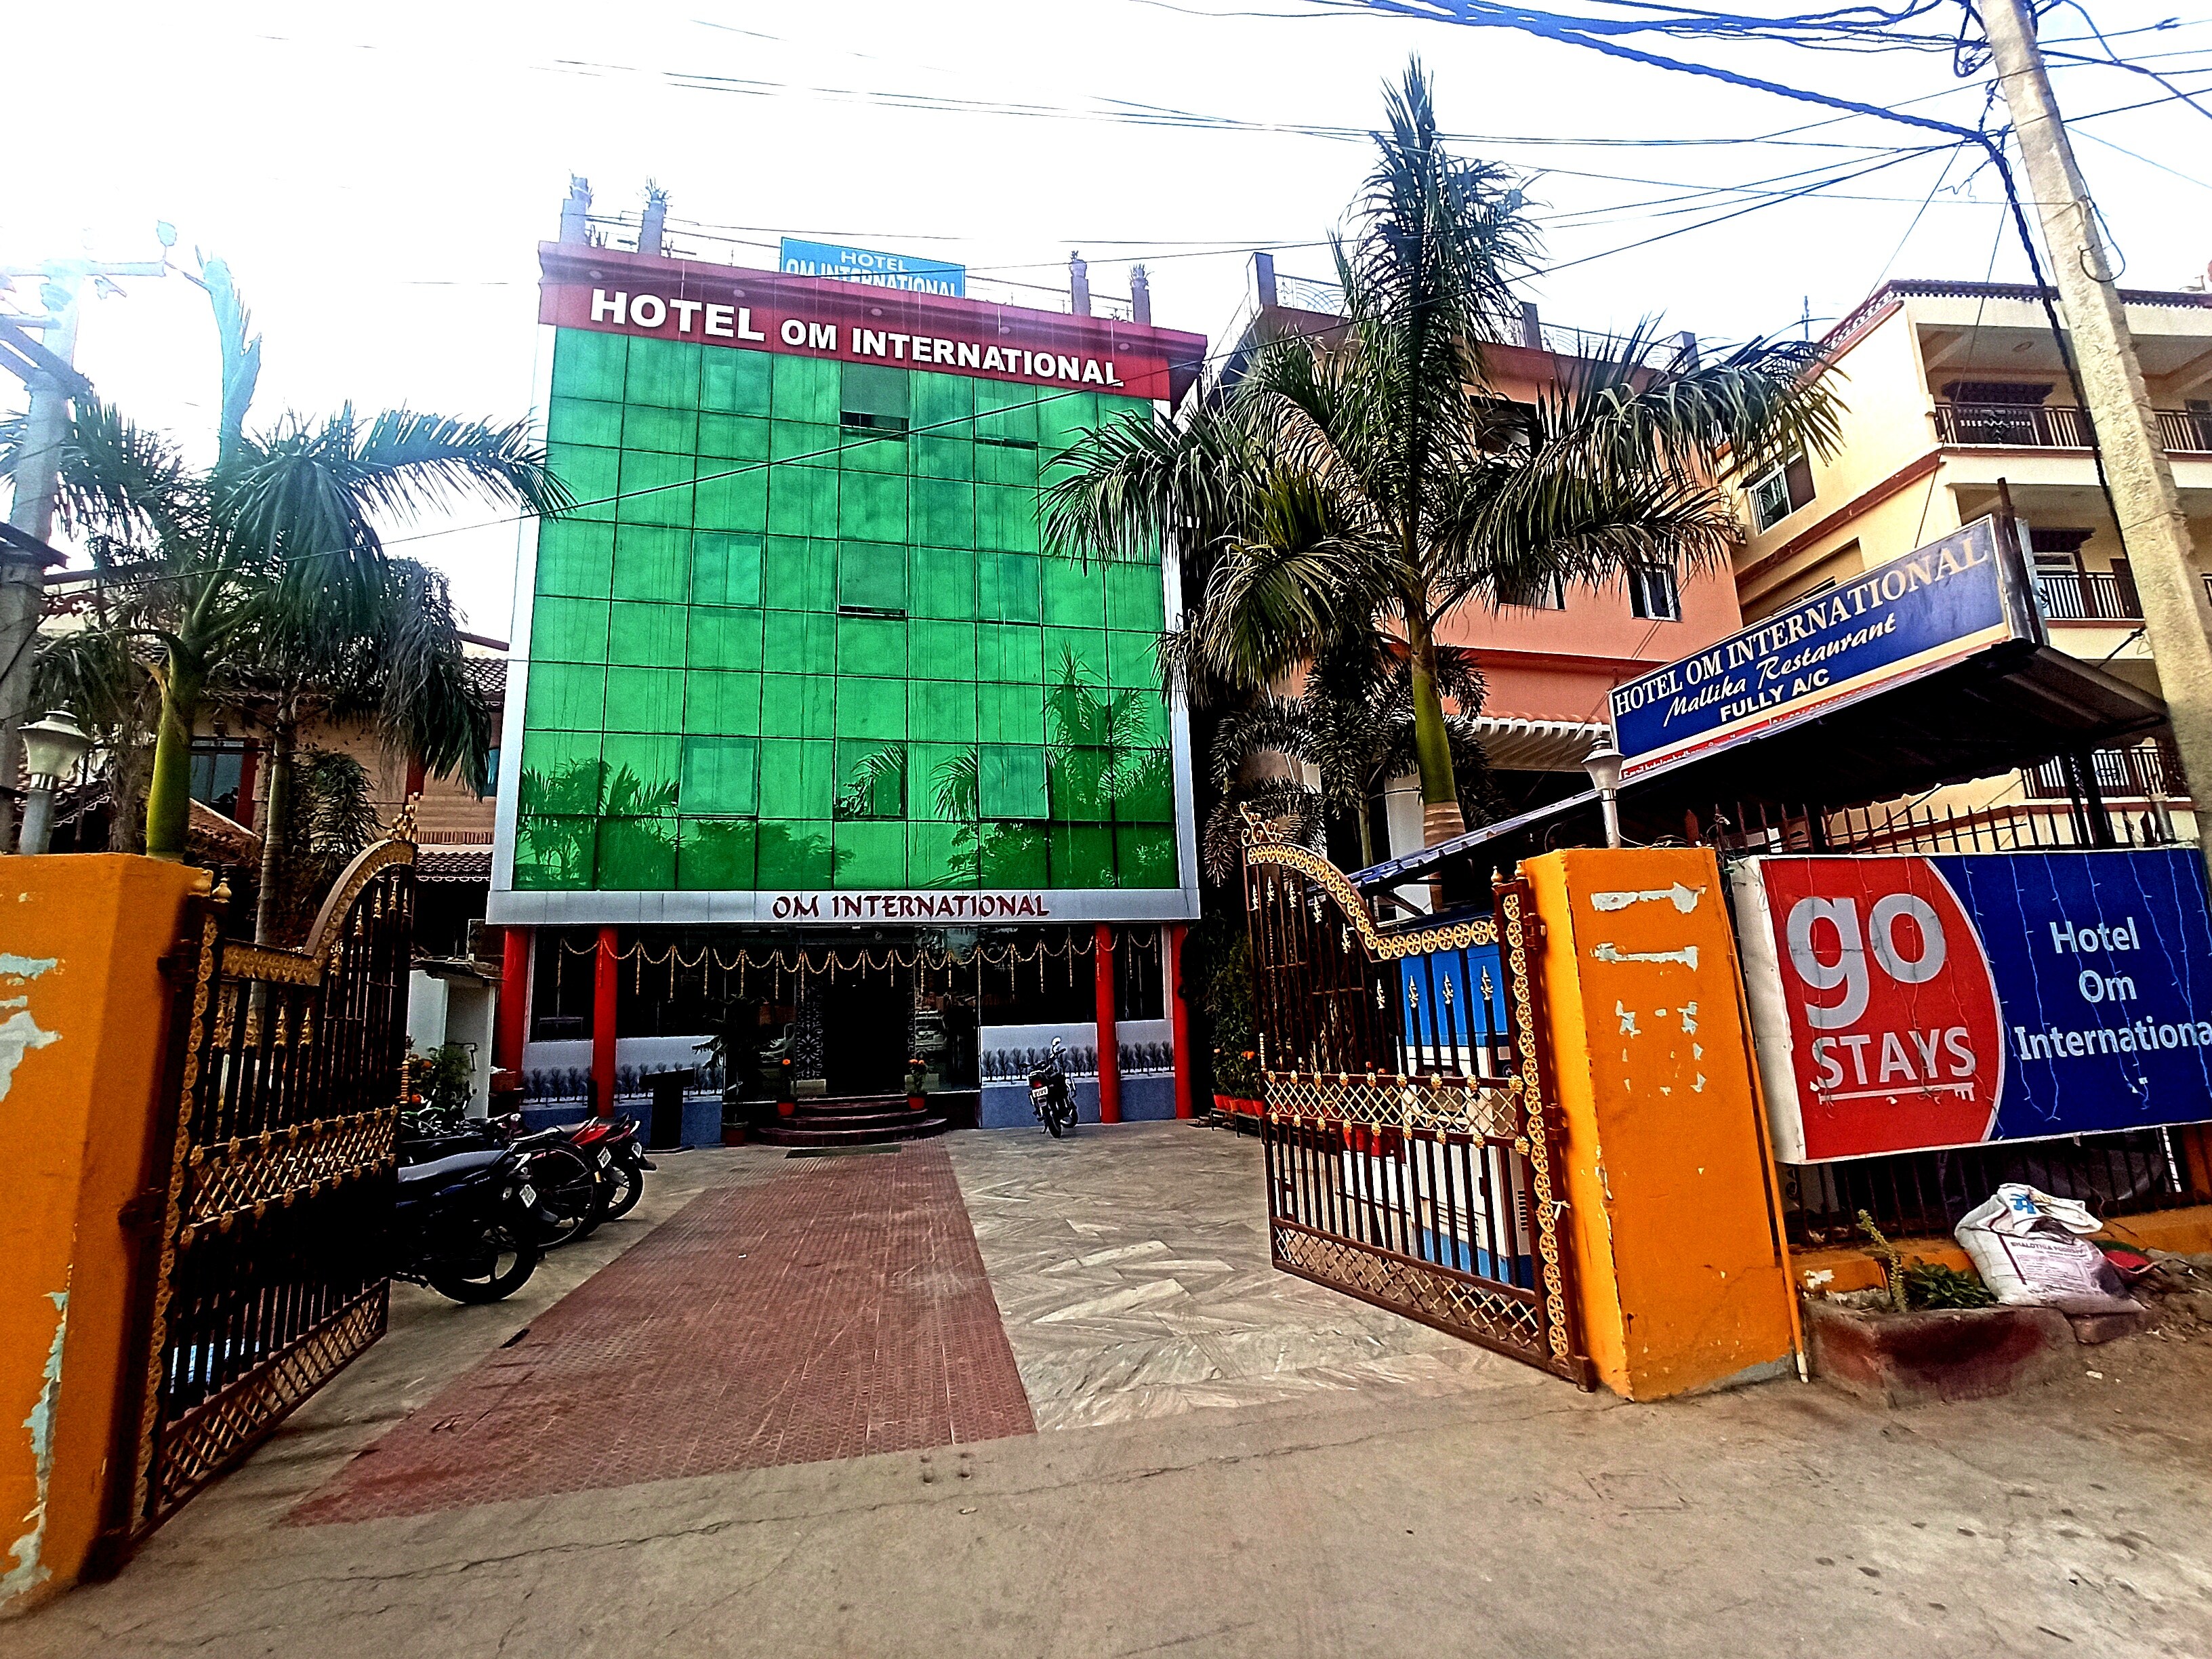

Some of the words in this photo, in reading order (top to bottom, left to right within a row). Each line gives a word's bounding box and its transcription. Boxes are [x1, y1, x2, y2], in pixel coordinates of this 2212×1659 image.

[785, 258, 815, 276] OM
[821, 262, 956, 297] INTERNATIONAL
[840, 250, 909, 272] HOTEL
[590, 288, 764, 342] HOTEL
[781, 319, 837, 350] OM
[852, 327, 1124, 387] INTERNATIONAL
[1614, 668, 1683, 717] HOTEL
[1685, 649, 1723, 687] OM
[1728, 537, 1988, 671] INTERNATIONAL
[1662, 675, 1746, 727] Mallika
[1755, 611, 1898, 690] Restaurant
[1719, 684, 1788, 722] FULLY
[1791, 668, 1830, 697] A/C
[771, 894, 819, 919] OM
[831, 894, 1050, 918] INTERNATIONAL
[1786, 892, 1947, 1029] go
[2049, 916, 2141, 954] Hotel
[2078, 969, 2137, 1003] Om
[1811, 1027, 1976, 1089] STAYS
[2013, 1011, 2212, 1060] Internationa
